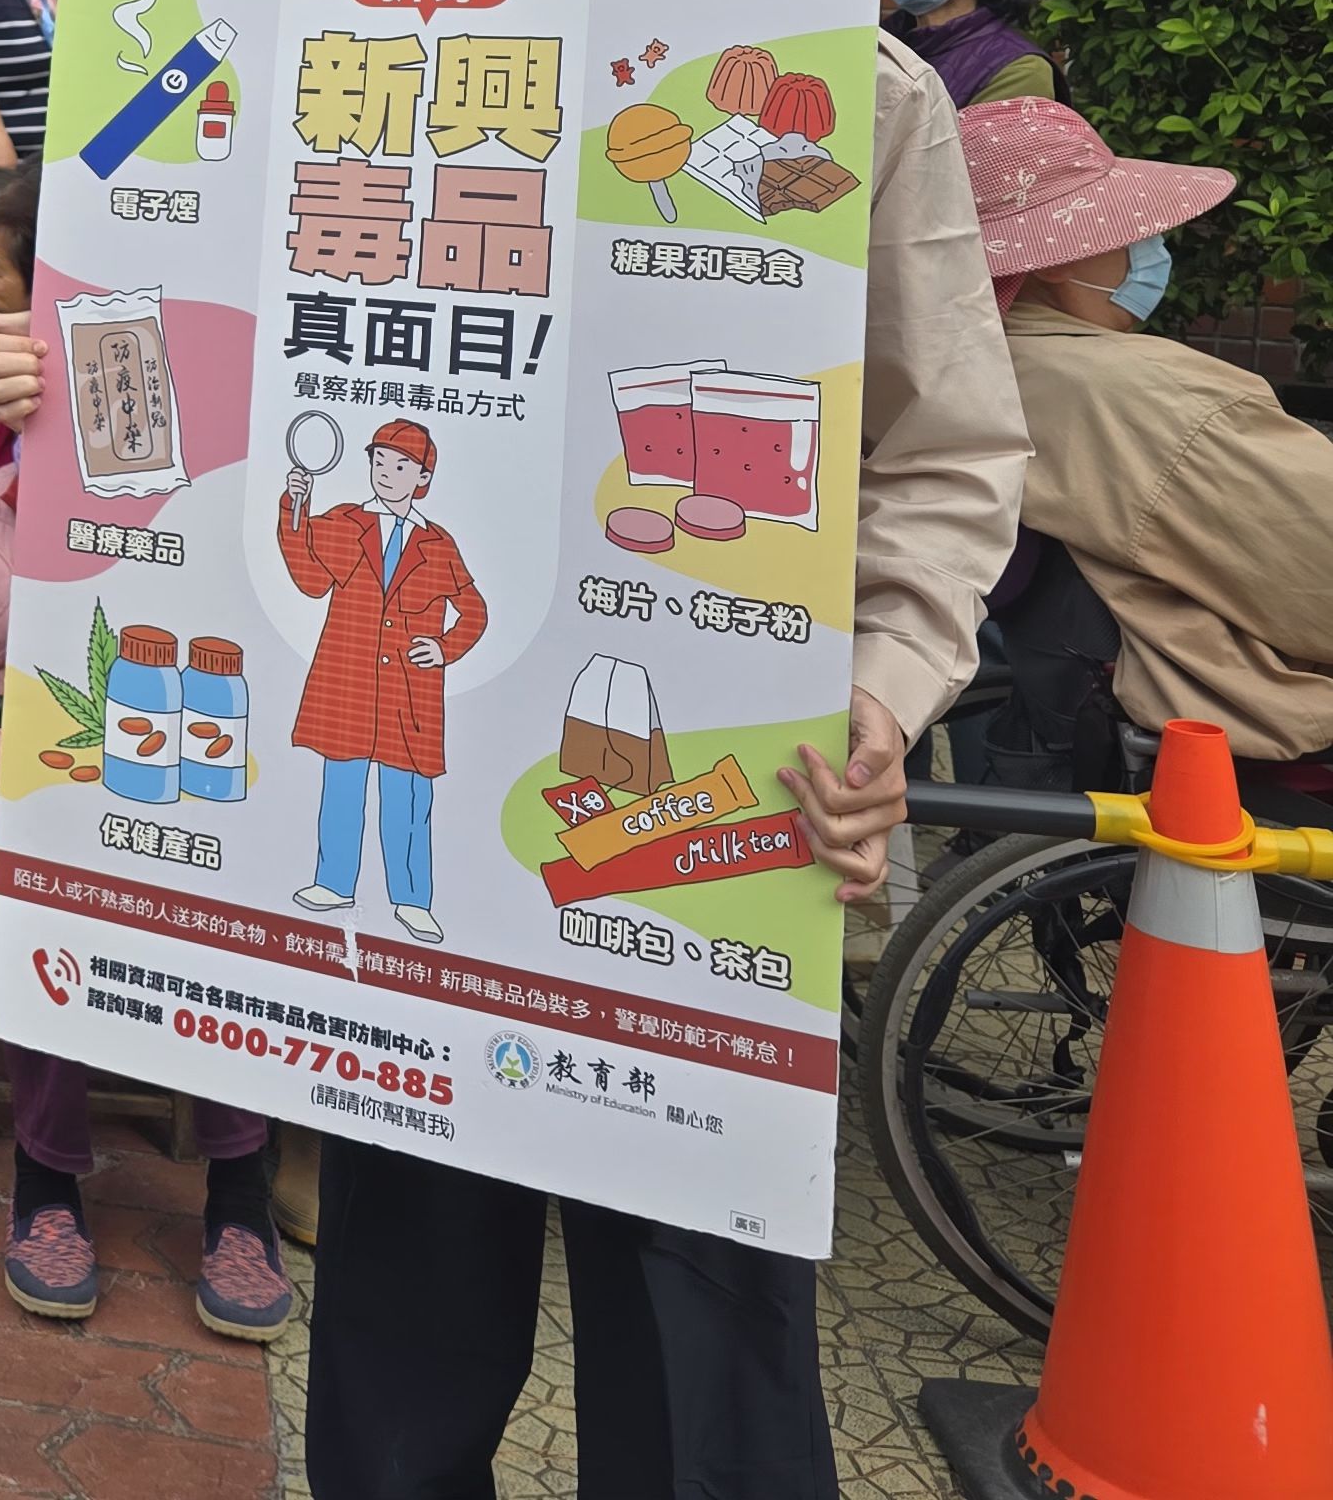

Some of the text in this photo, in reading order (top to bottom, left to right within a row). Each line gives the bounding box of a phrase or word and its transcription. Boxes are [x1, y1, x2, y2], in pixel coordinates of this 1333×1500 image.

[292, 30, 563, 163] 新興
[110, 187, 200, 224] 電子煙
[286, 157, 553, 298] 毒品
[610, 240, 805, 287] 糖果和零食
[283, 290, 553, 381] 真面目!
[293, 371, 526, 421] 覺察新興毒品方式
[66, 517, 185, 567] 醫療藥品
[578, 576, 811, 644] 梅片、梅子粉
[623, 790, 715, 835] coffee
[99, 811, 222, 870] 保健產品
[674, 829, 792, 874] Milk tea
[559, 907, 792, 991] 咖啡包、茶包
[87, 986, 455, 1106] 諮詢專線 0800-770-885
[546, 1048, 657, 1103] 教育部
[546, 1081, 657, 1120] Ministry of Education
[309, 1083, 456, 1142] (請請你幫幫我)
[666, 1104, 725, 1136] 關心您
[734, 1215, 763, 1235] 廣告
